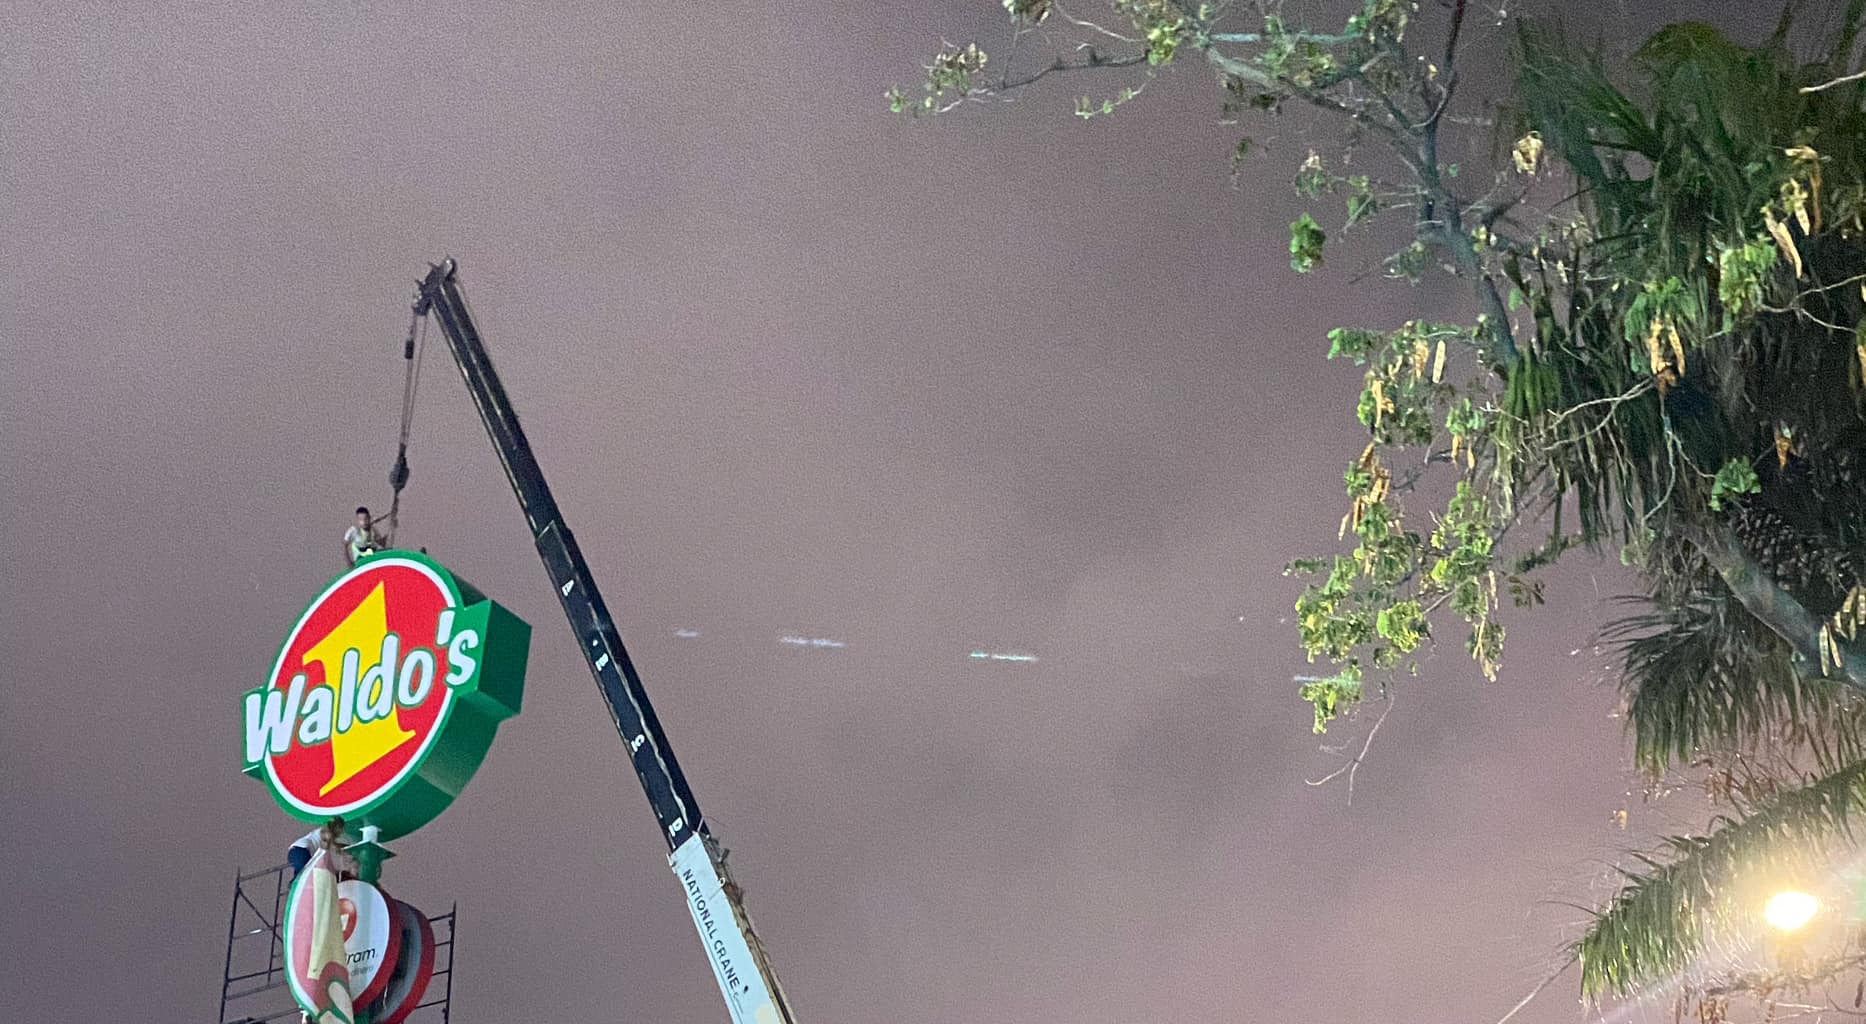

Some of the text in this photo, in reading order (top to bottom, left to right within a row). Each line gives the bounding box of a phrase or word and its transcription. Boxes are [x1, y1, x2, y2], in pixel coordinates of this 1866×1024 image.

[244, 608, 480, 764] Waldo's
[346, 948, 376, 965] ram
[682, 868, 741, 990] NATIONAL CRANE
